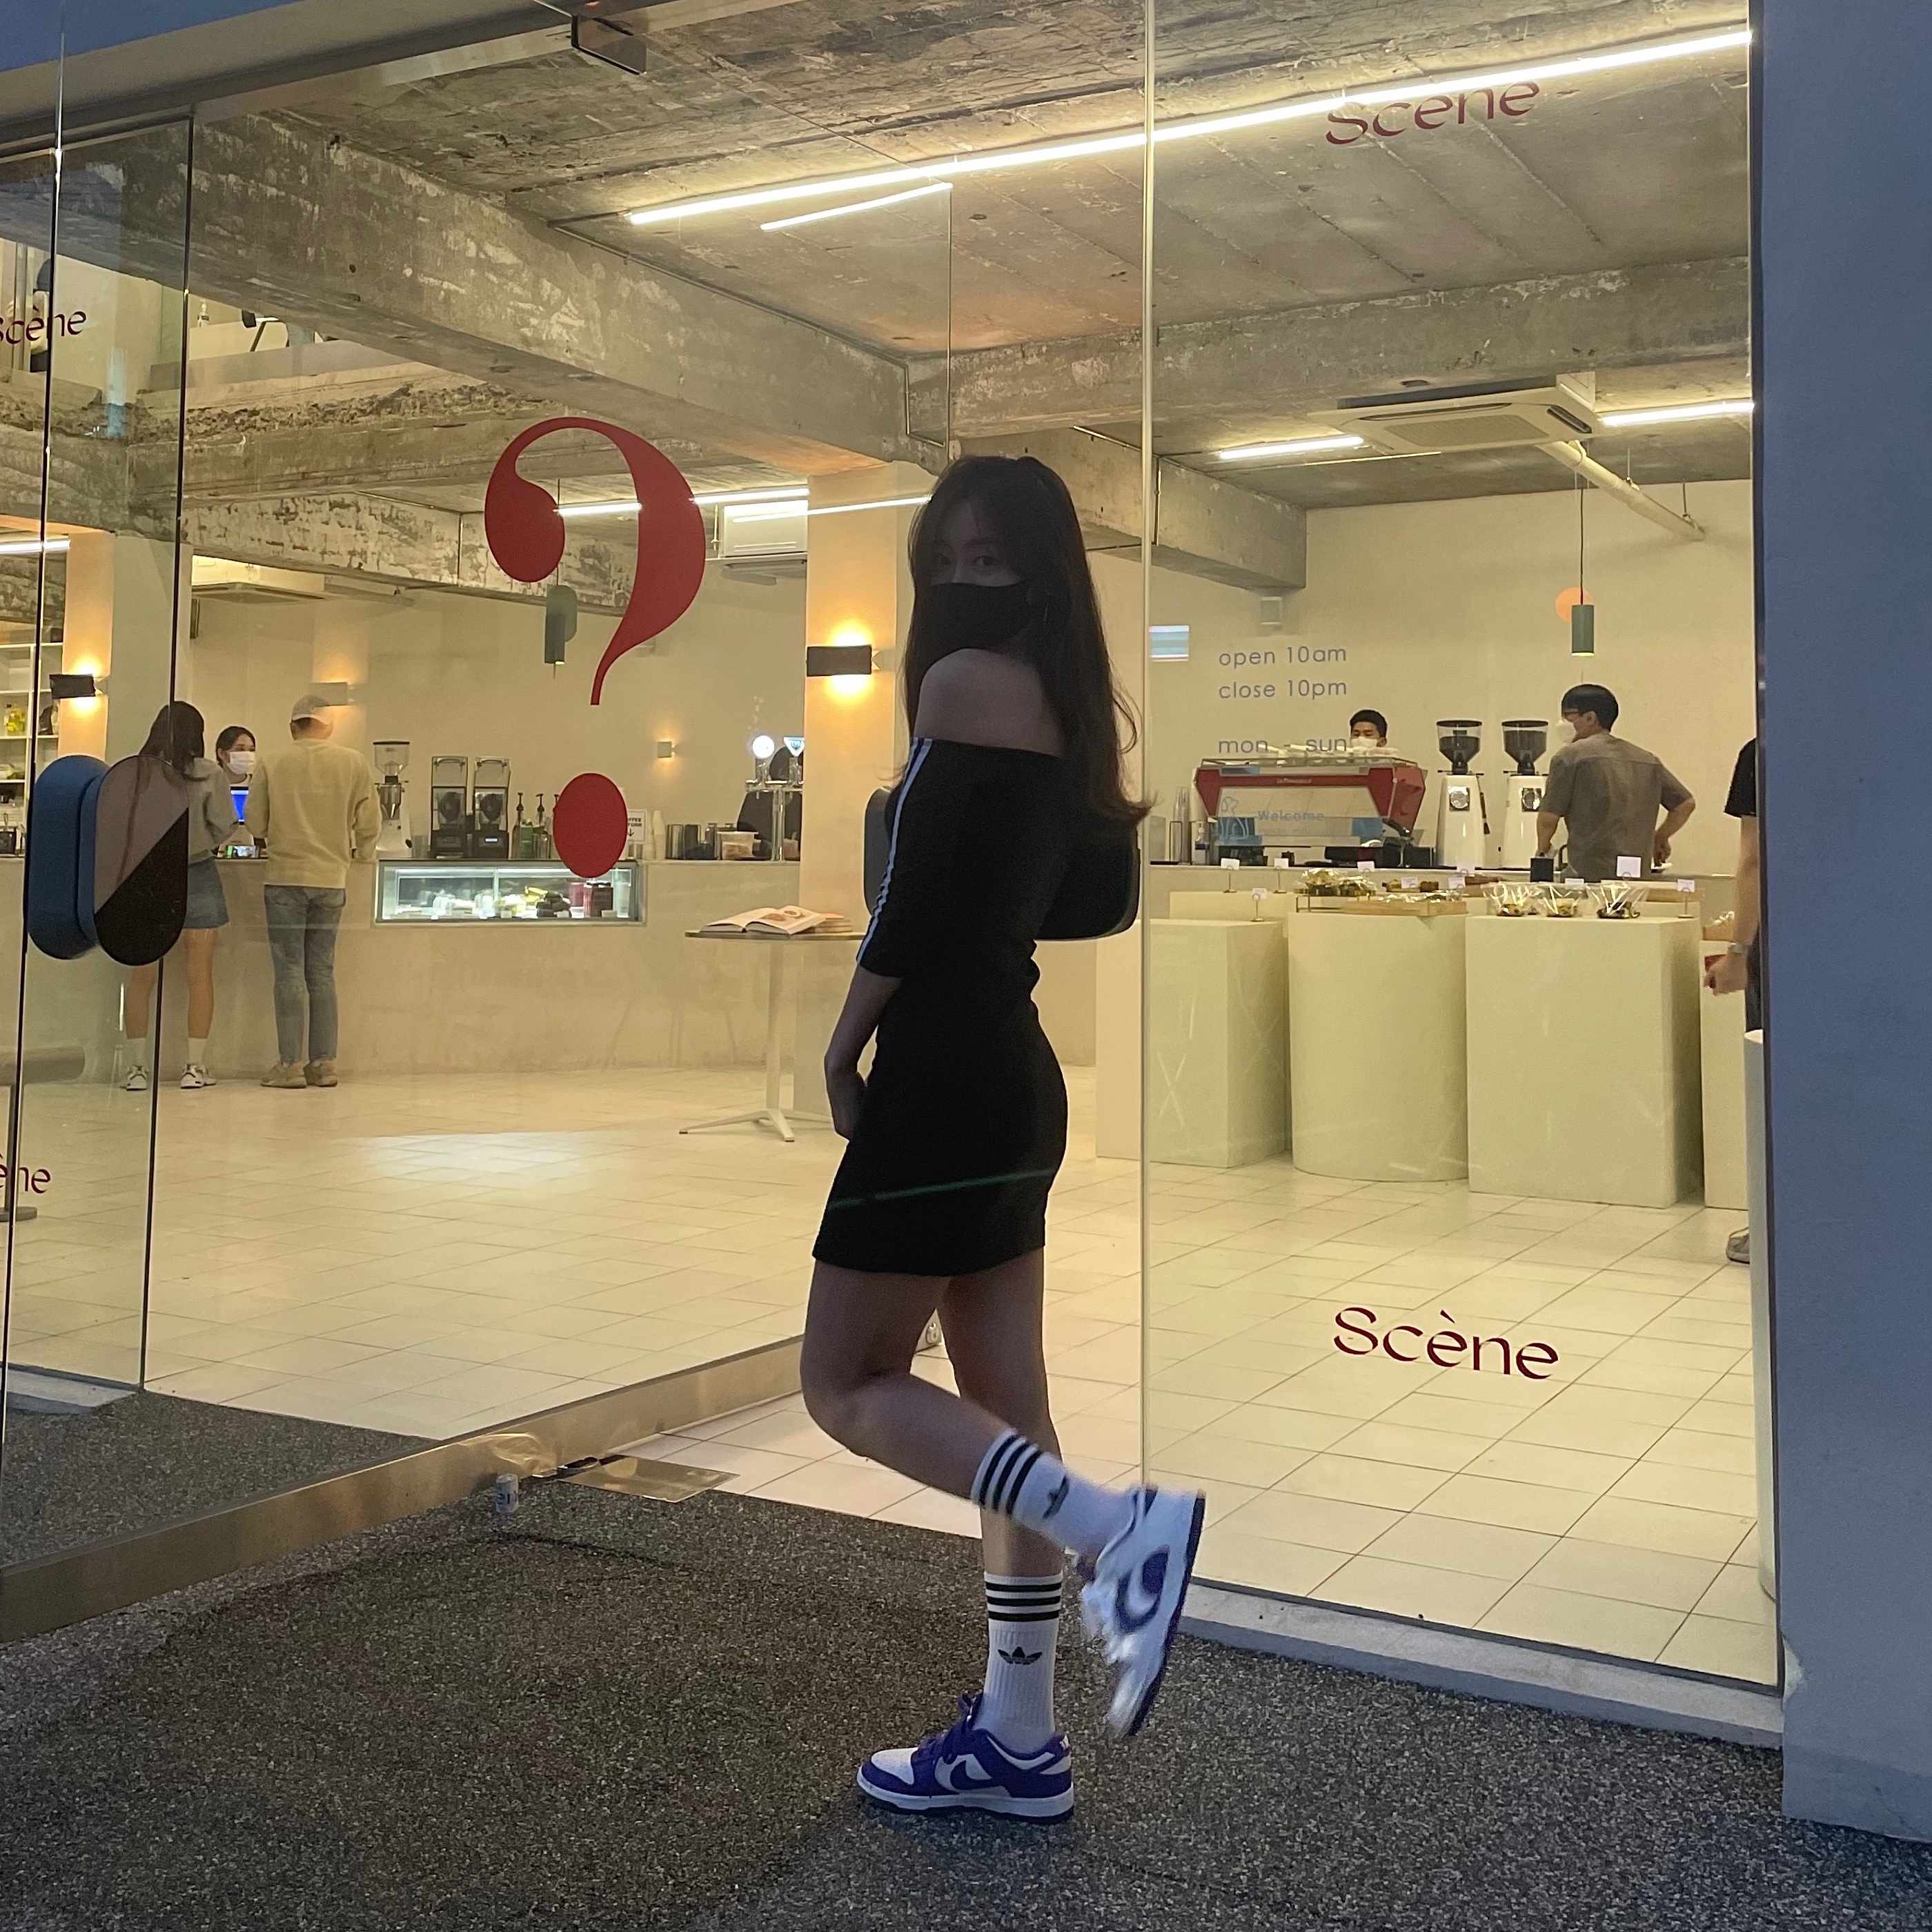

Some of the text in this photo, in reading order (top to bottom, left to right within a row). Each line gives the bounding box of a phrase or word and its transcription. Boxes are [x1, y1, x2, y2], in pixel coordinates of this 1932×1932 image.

[0, 306, 87, 344] cène
[1219, 646, 1346, 669] open 10am
[1219, 679, 1347, 700] close 10pm
[1219, 740, 1268, 753] mon
[1305, 738, 1347, 752] sun
[1258, 810, 1324, 821] Welcome
[1334, 1307, 1559, 1380] Scène
